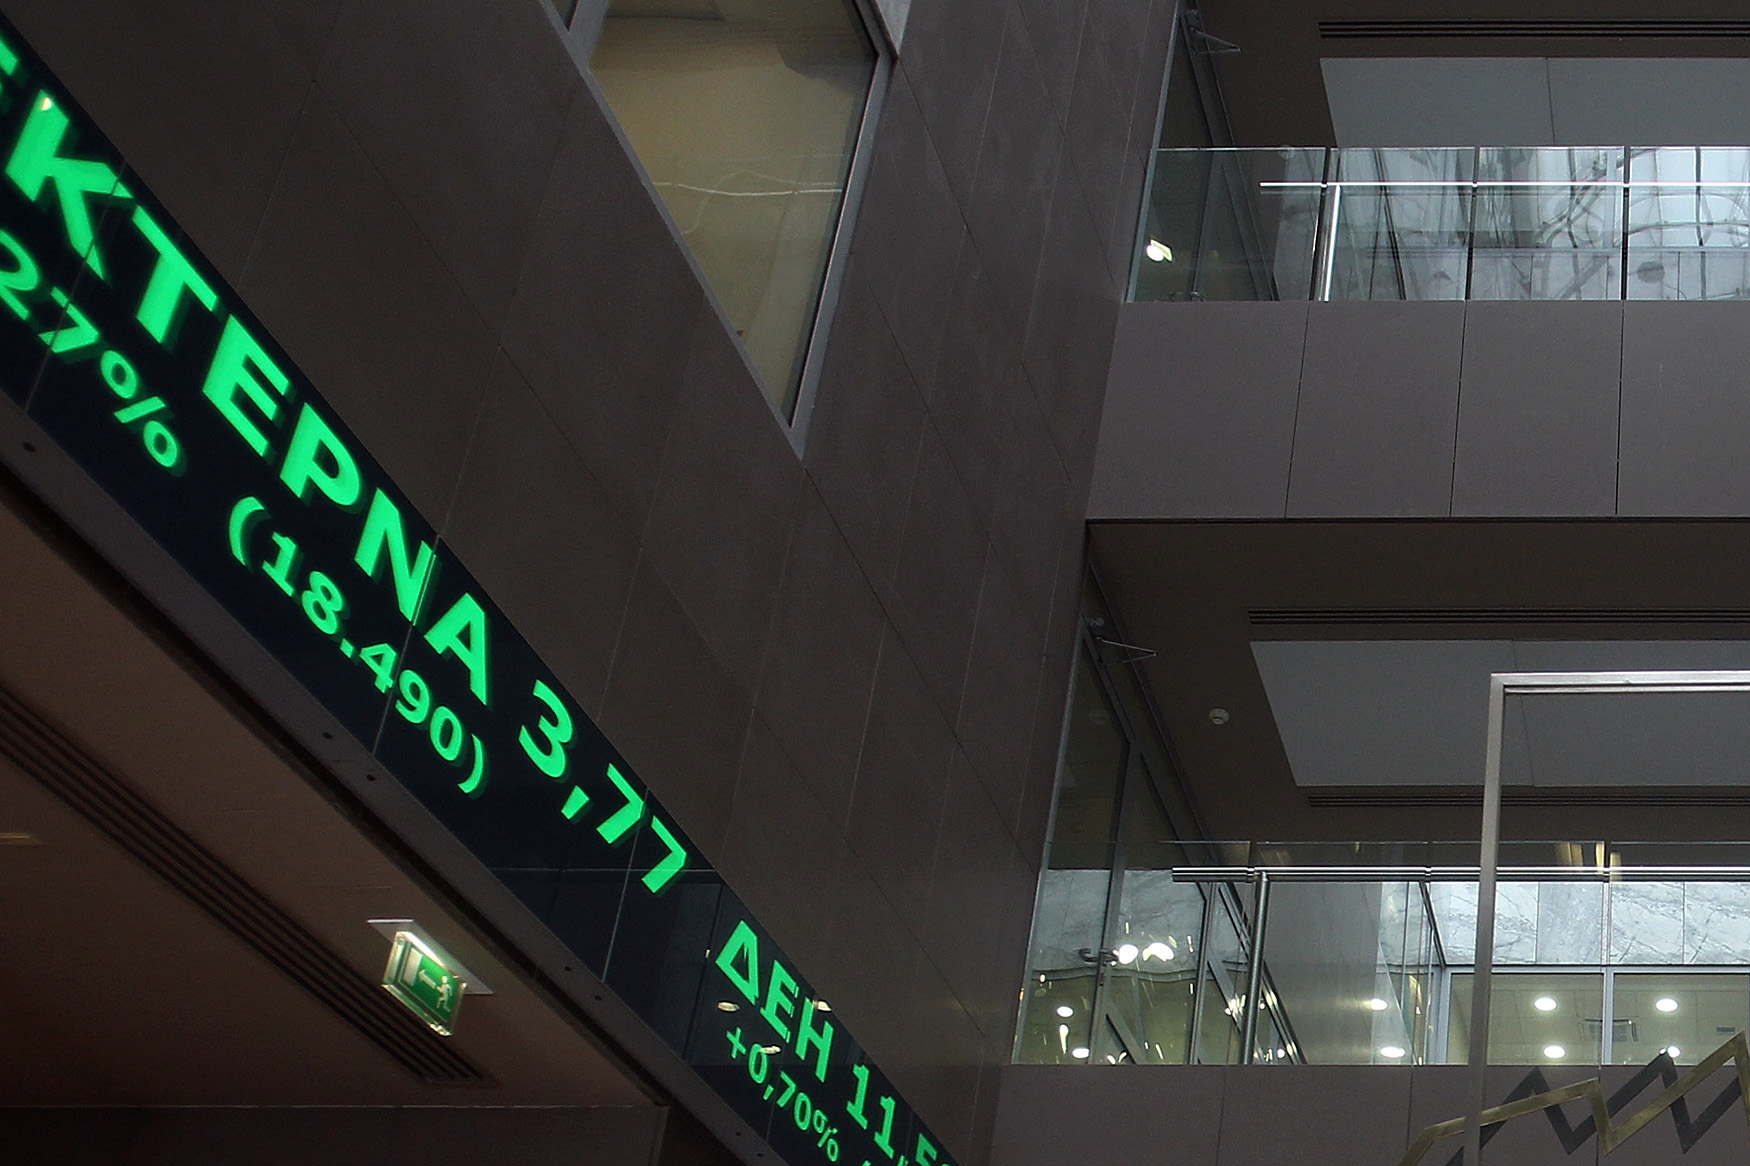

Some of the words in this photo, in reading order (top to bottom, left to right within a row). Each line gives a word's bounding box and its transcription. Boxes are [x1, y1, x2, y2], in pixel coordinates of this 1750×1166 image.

[0, 38, 488, 706] ΚΤΕΡΝΑ
[518, 679, 687, 894] 3,77
[715, 919, 834, 1083] ΔΕΗ
[228, 496, 485, 794] (18.490)
[726, 1026, 840, 1163] +0,70%
